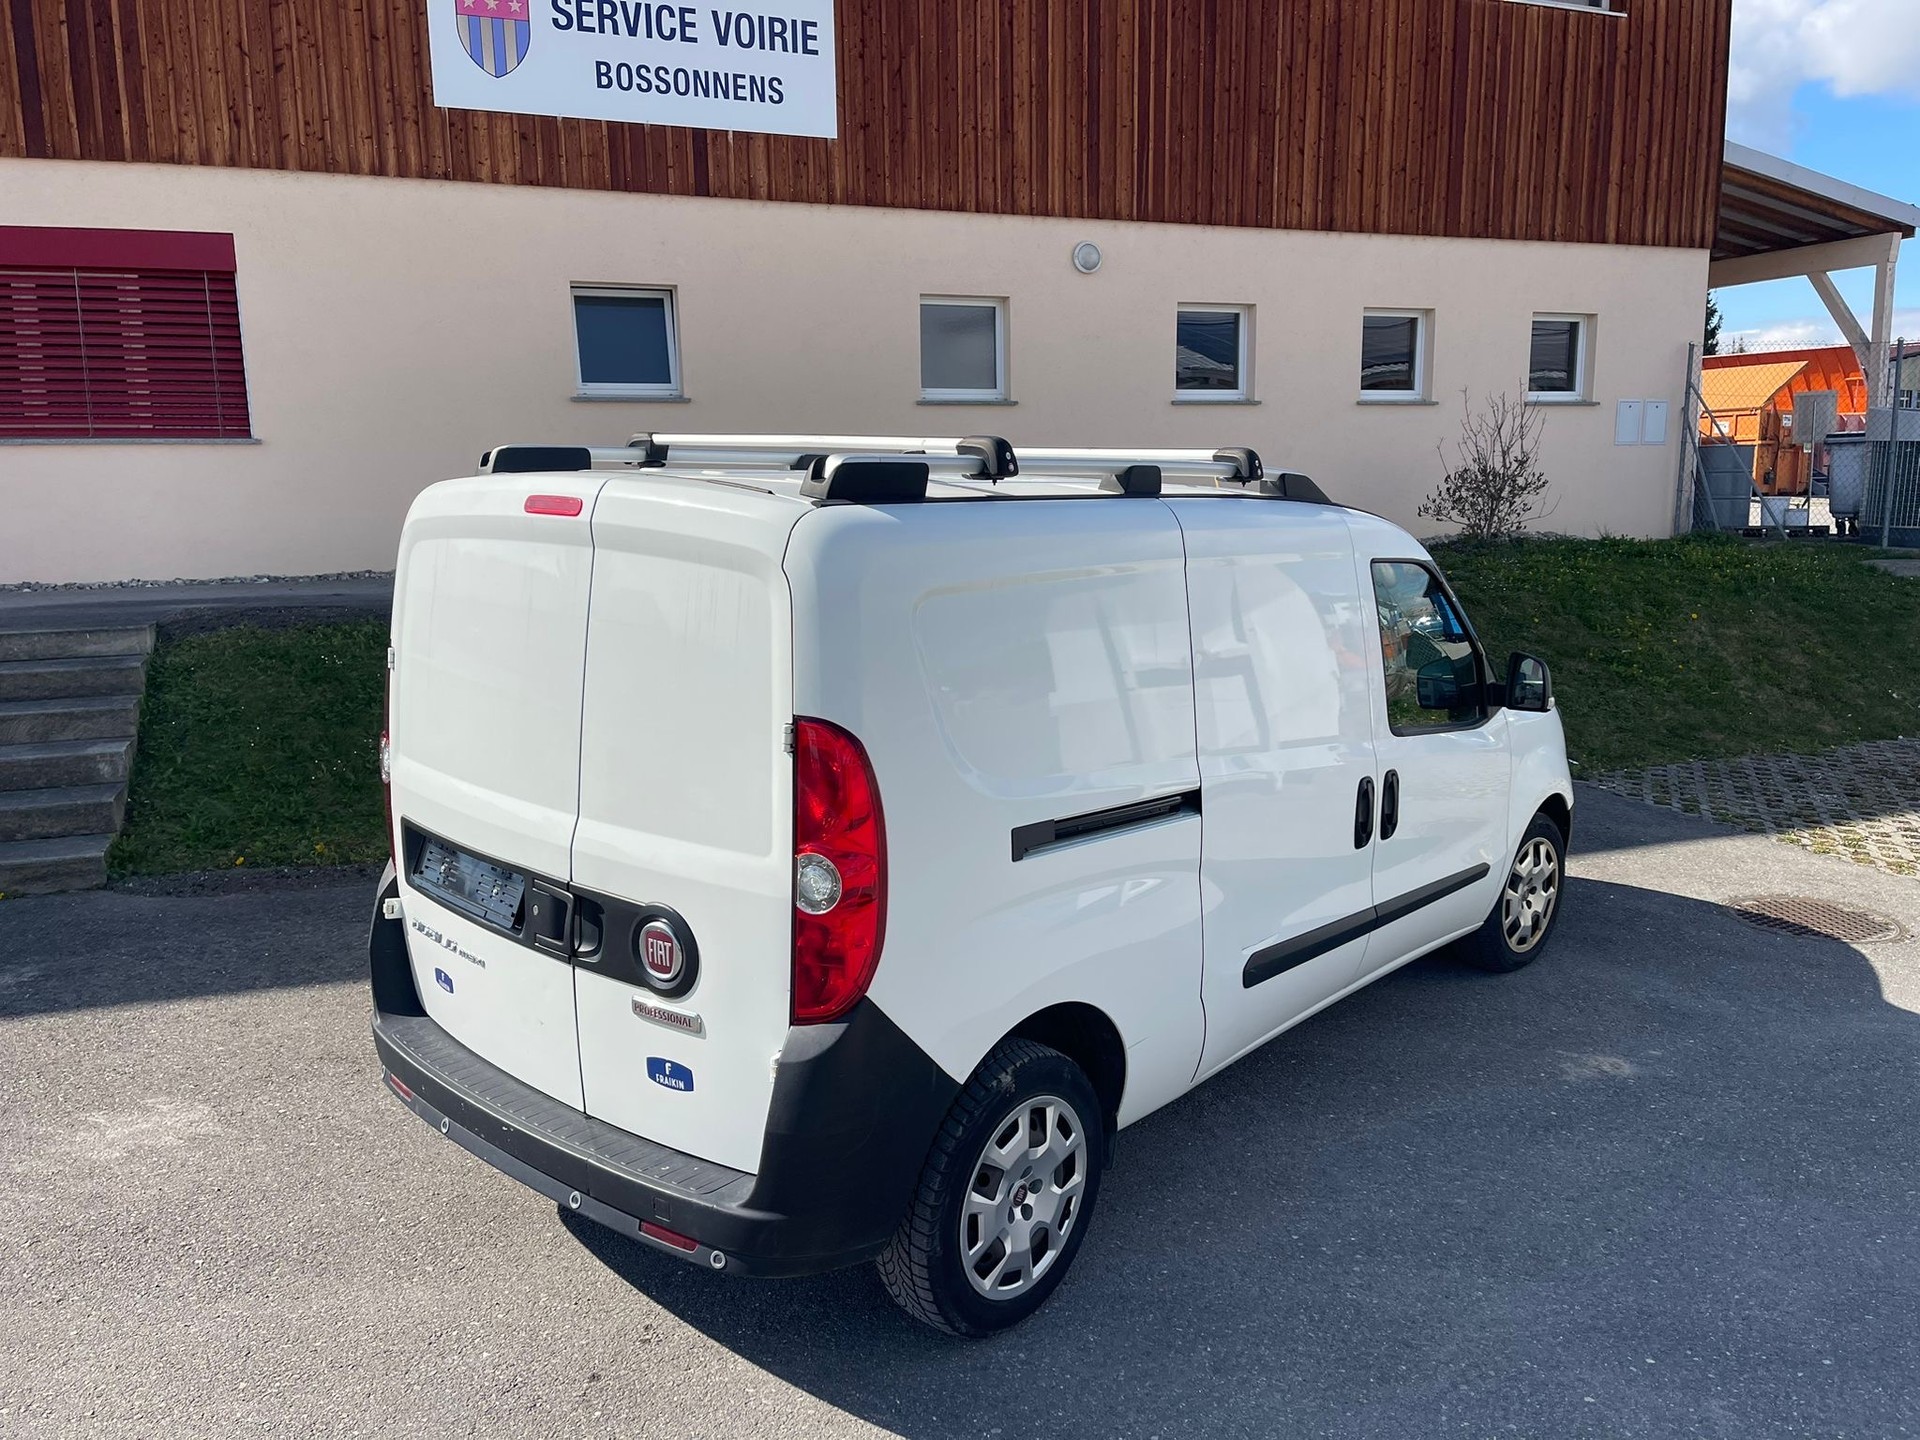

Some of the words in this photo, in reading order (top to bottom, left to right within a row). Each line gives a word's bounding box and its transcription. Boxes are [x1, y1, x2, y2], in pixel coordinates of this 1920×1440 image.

[551, 0, 698, 43] SERVICE
[711, 10, 819, 56] VOIRIE
[595, 60, 784, 105] BOSSONNENS
[648, 938, 671, 967] FIAT
[634, 1002, 693, 1028] PROFESSIONAL
[655, 1073, 685, 1090] FRAIKIN
